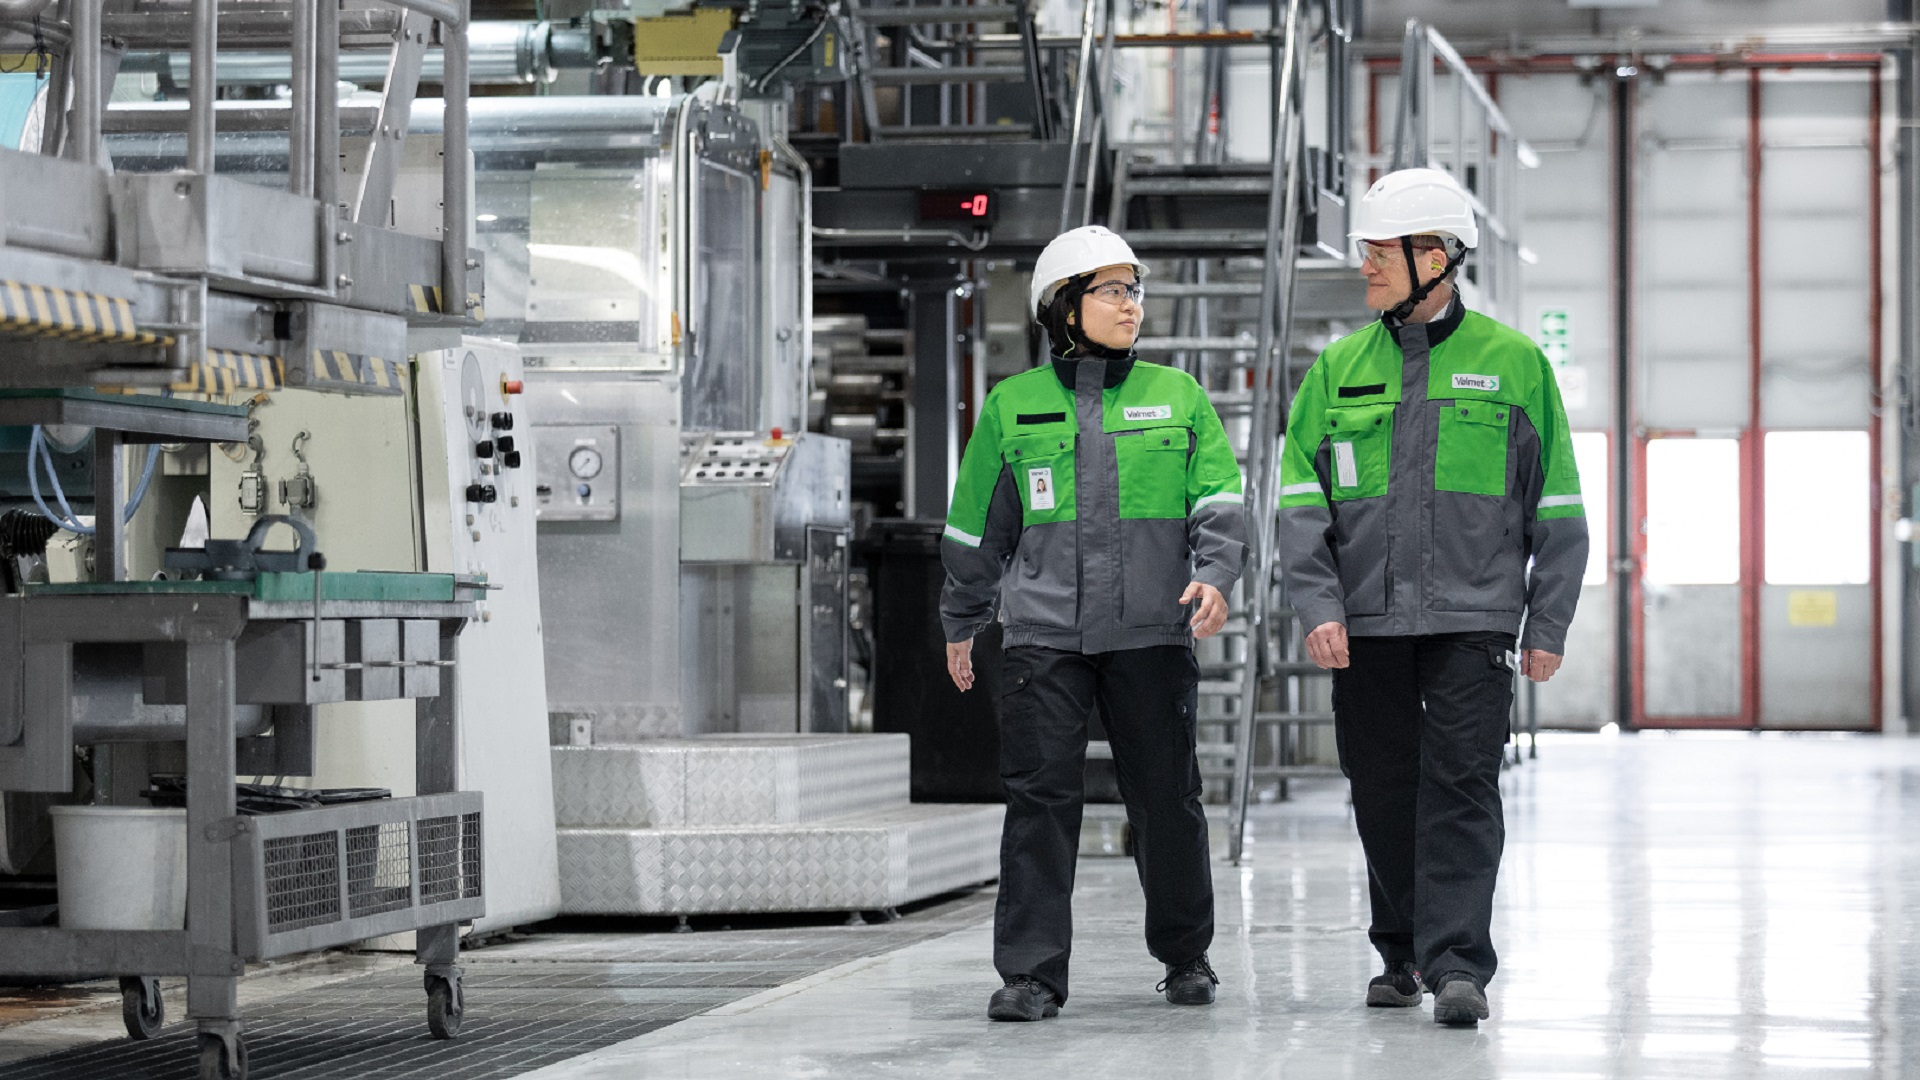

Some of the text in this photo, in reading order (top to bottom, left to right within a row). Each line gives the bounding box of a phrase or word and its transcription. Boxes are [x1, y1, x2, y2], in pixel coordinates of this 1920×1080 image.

[960, 194, 988, 216] -0
[1454, 376, 1485, 388] Valmet
[1125, 410, 1157, 418] Valmet
